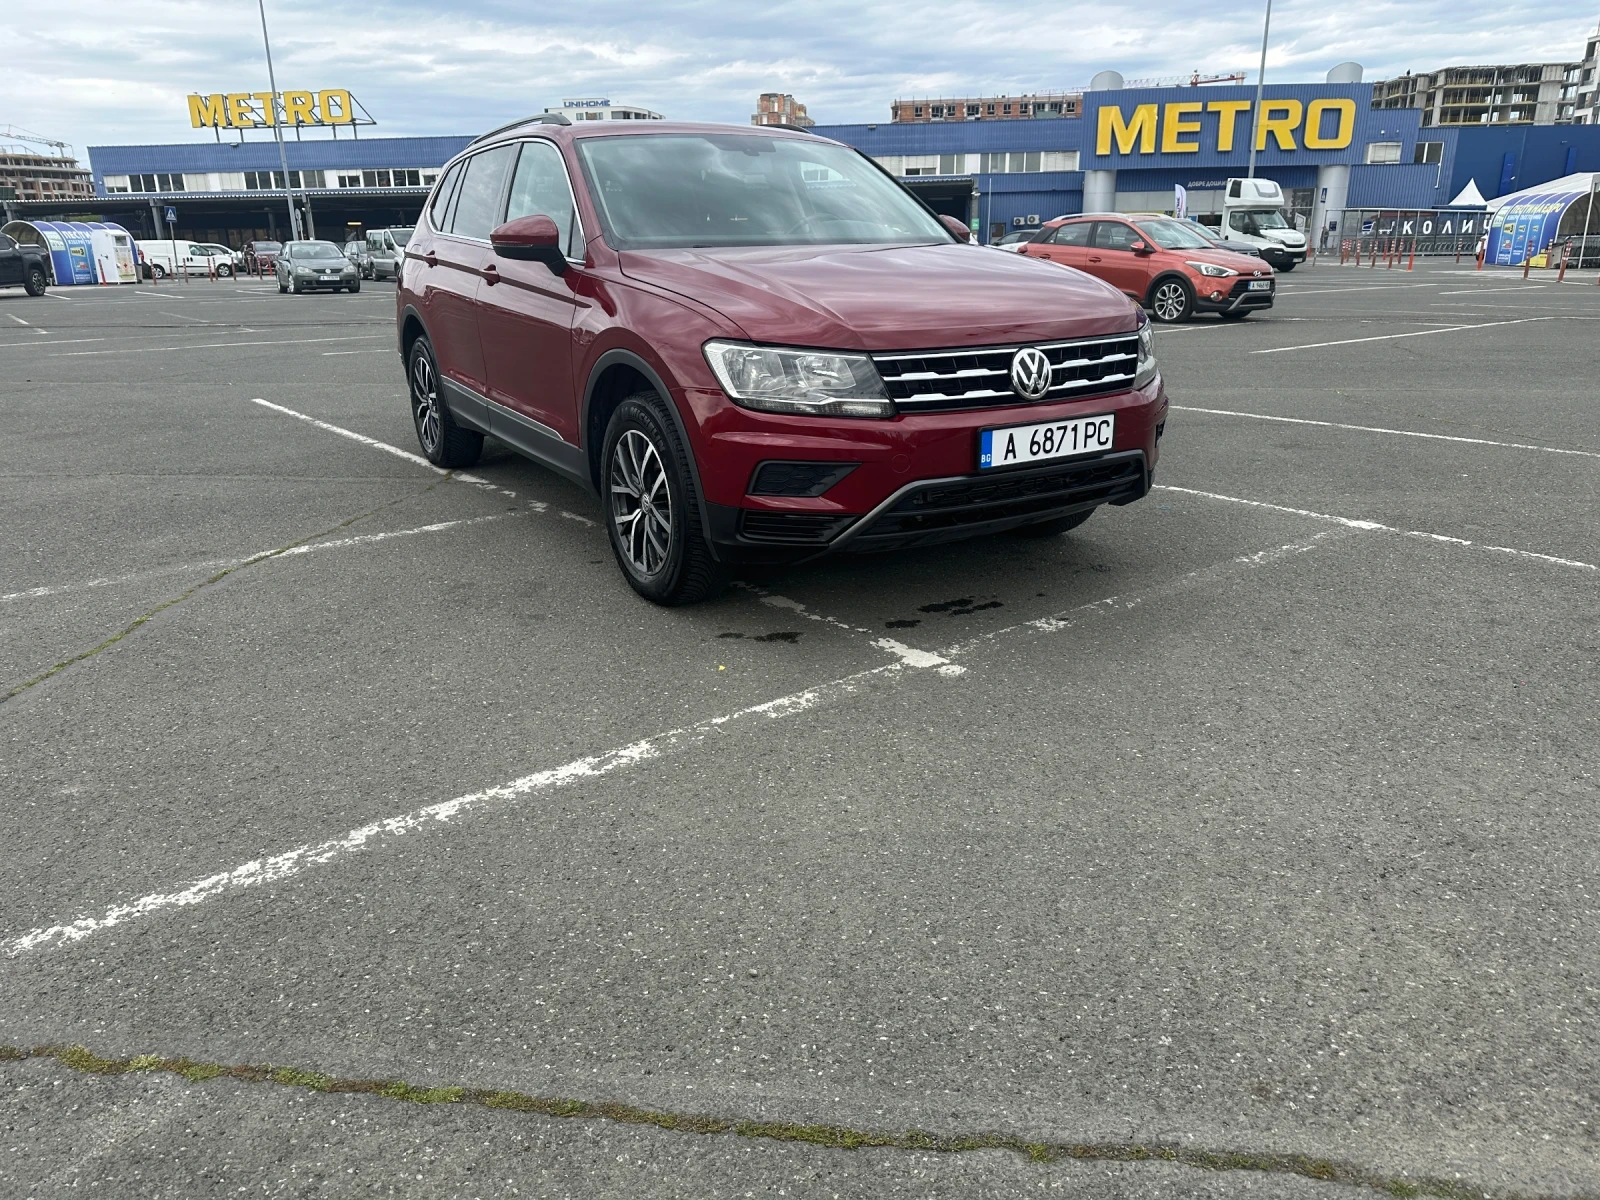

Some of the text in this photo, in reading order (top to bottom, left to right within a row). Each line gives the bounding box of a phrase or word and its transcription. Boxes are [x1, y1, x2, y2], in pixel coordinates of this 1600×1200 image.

[187, 89, 353, 128] METRO
[563, 100, 611, 108] UNIHOME
[1096, 98, 1356, 155] METRO
[629, 406, 666, 453] MICHELIN
[1003, 419, 1110, 460] A 6871PC
[981, 454, 991, 463] BG
